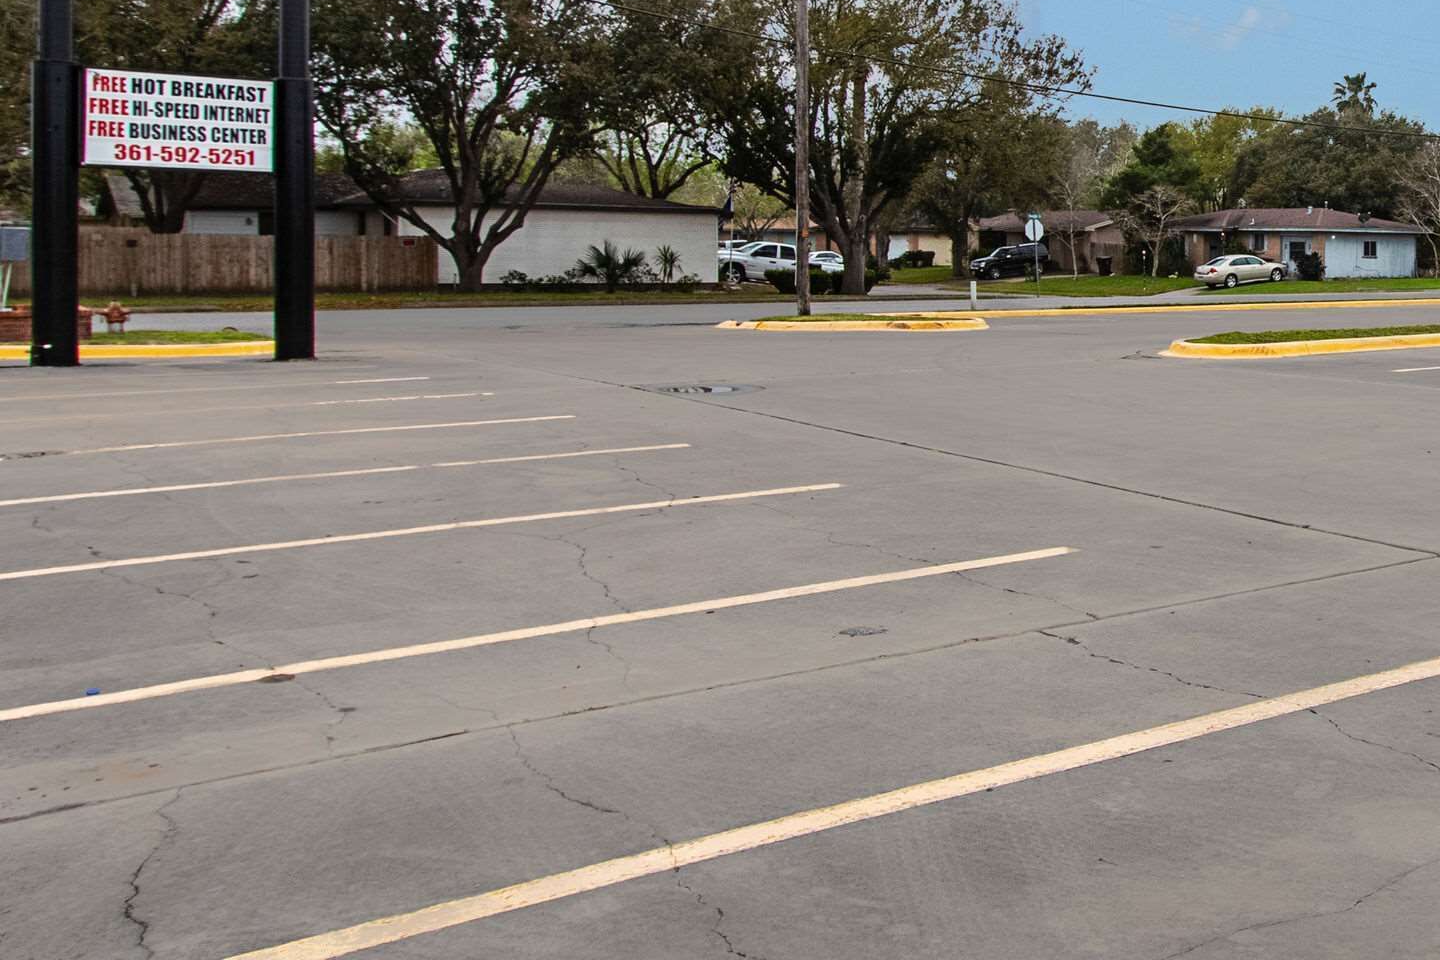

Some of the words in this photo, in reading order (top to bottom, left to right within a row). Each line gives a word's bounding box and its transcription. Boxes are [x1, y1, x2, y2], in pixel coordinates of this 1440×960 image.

[93, 76, 127, 93] FREE
[131, 78, 167, 96] HOT
[171, 81, 267, 103] BREAKFAST
[89, 98, 129, 115] FREE
[132, 101, 200, 120] HI-SPEED
[204, 104, 270, 124] INTERNET
[89, 120, 125, 138] FREE
[129, 123, 206, 142] BUSINESS
[211, 127, 267, 144] CENTER
[114, 144, 255, 166] 361-592-5251
